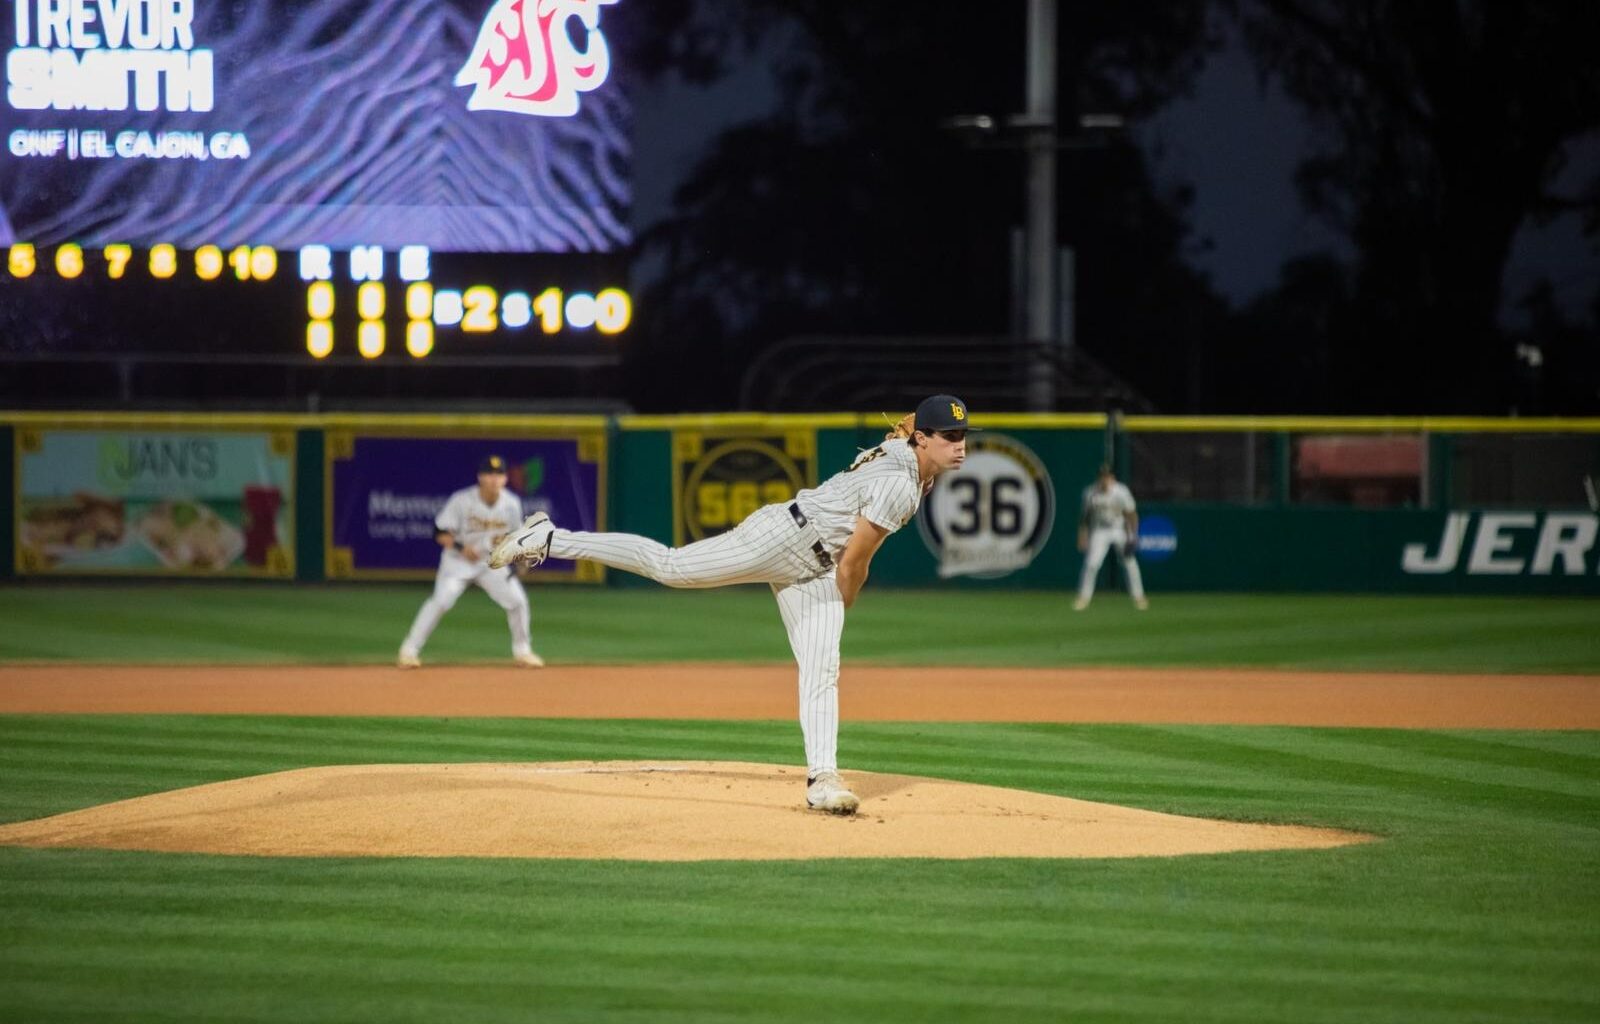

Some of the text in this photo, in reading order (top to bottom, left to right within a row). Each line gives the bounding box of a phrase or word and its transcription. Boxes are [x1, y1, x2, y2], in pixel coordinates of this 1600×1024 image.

[14, 0, 194, 49] TREVOR
[7, 48, 214, 111] SMITH
[81, 130, 114, 158] EL
[210, 131, 250, 159] CA
[8, 243, 36, 279] 5
[55, 243, 84, 279] 6
[104, 244, 132, 279] 7
[149, 243, 177, 279] 8
[195, 244, 223, 280] 9
[229, 245, 277, 280] 10
[300, 245, 332, 280] R
[461, 285, 498, 332] 2
[533, 287, 563, 334] 1
[950, 476, 1023, 536] 36
[1401, 511, 1600, 576] JER
